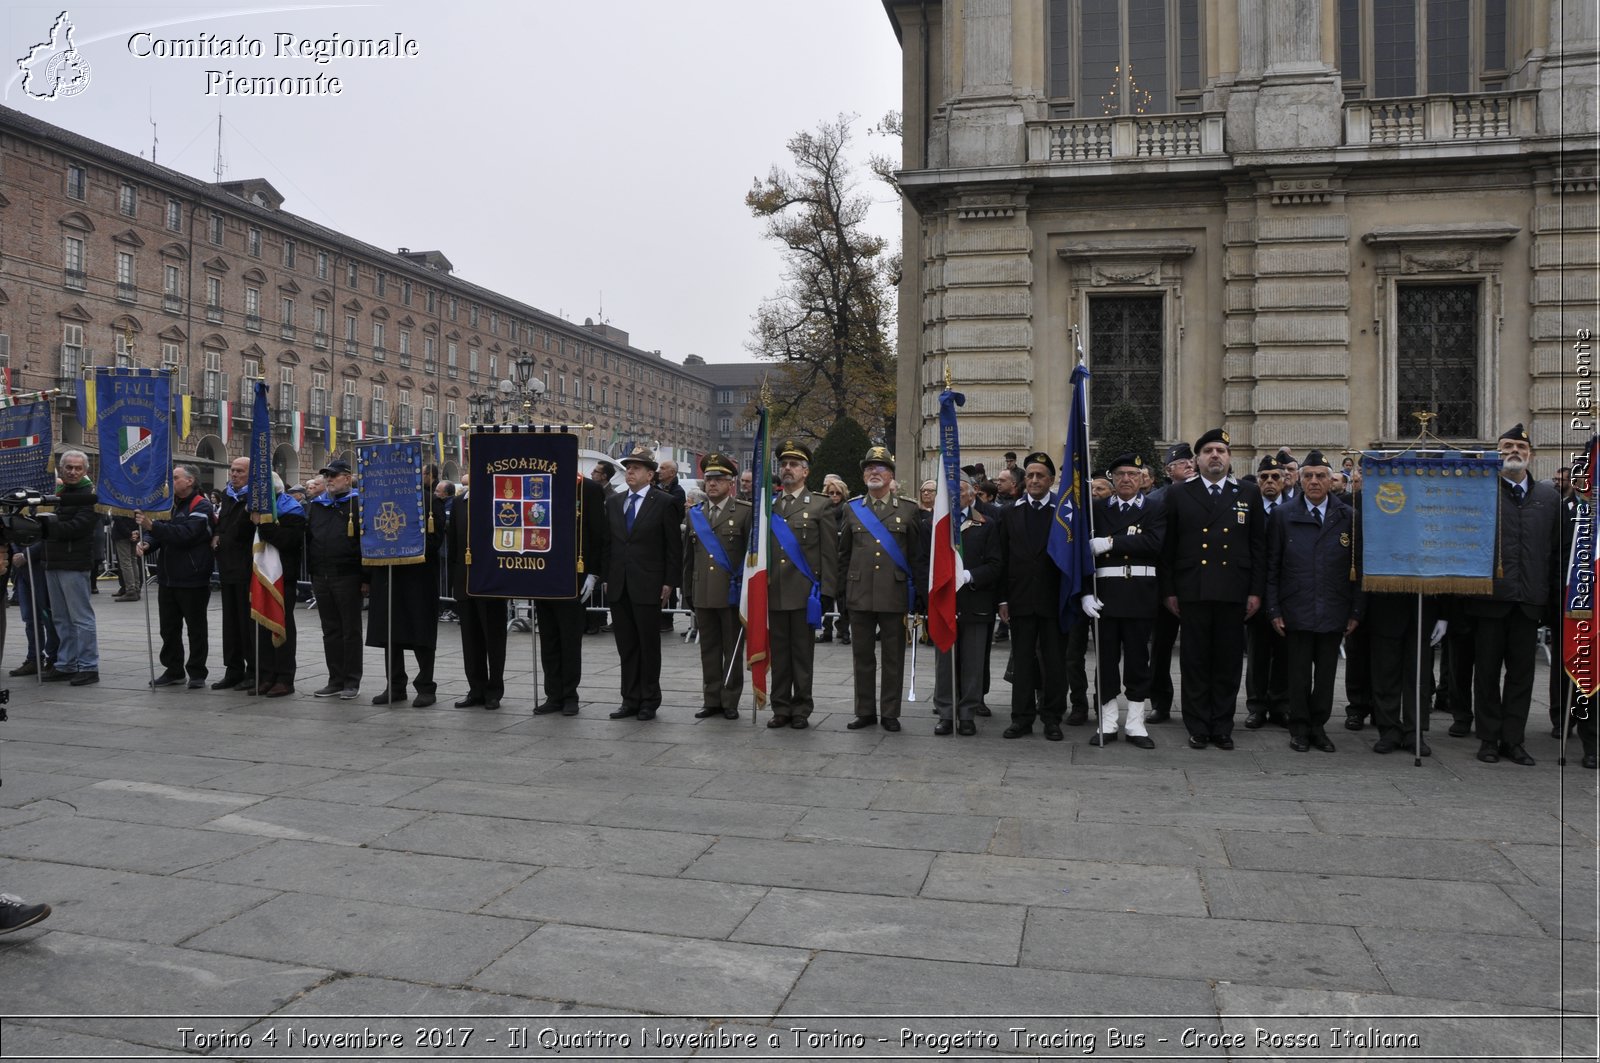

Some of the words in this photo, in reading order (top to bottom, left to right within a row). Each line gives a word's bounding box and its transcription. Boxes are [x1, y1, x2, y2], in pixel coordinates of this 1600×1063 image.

[944, 425, 954, 457] FANTE
[486, 457, 558, 475] ASSOARMA
[371, 477, 409, 487] ITALIANA
[497, 556, 545, 570] TORINO
